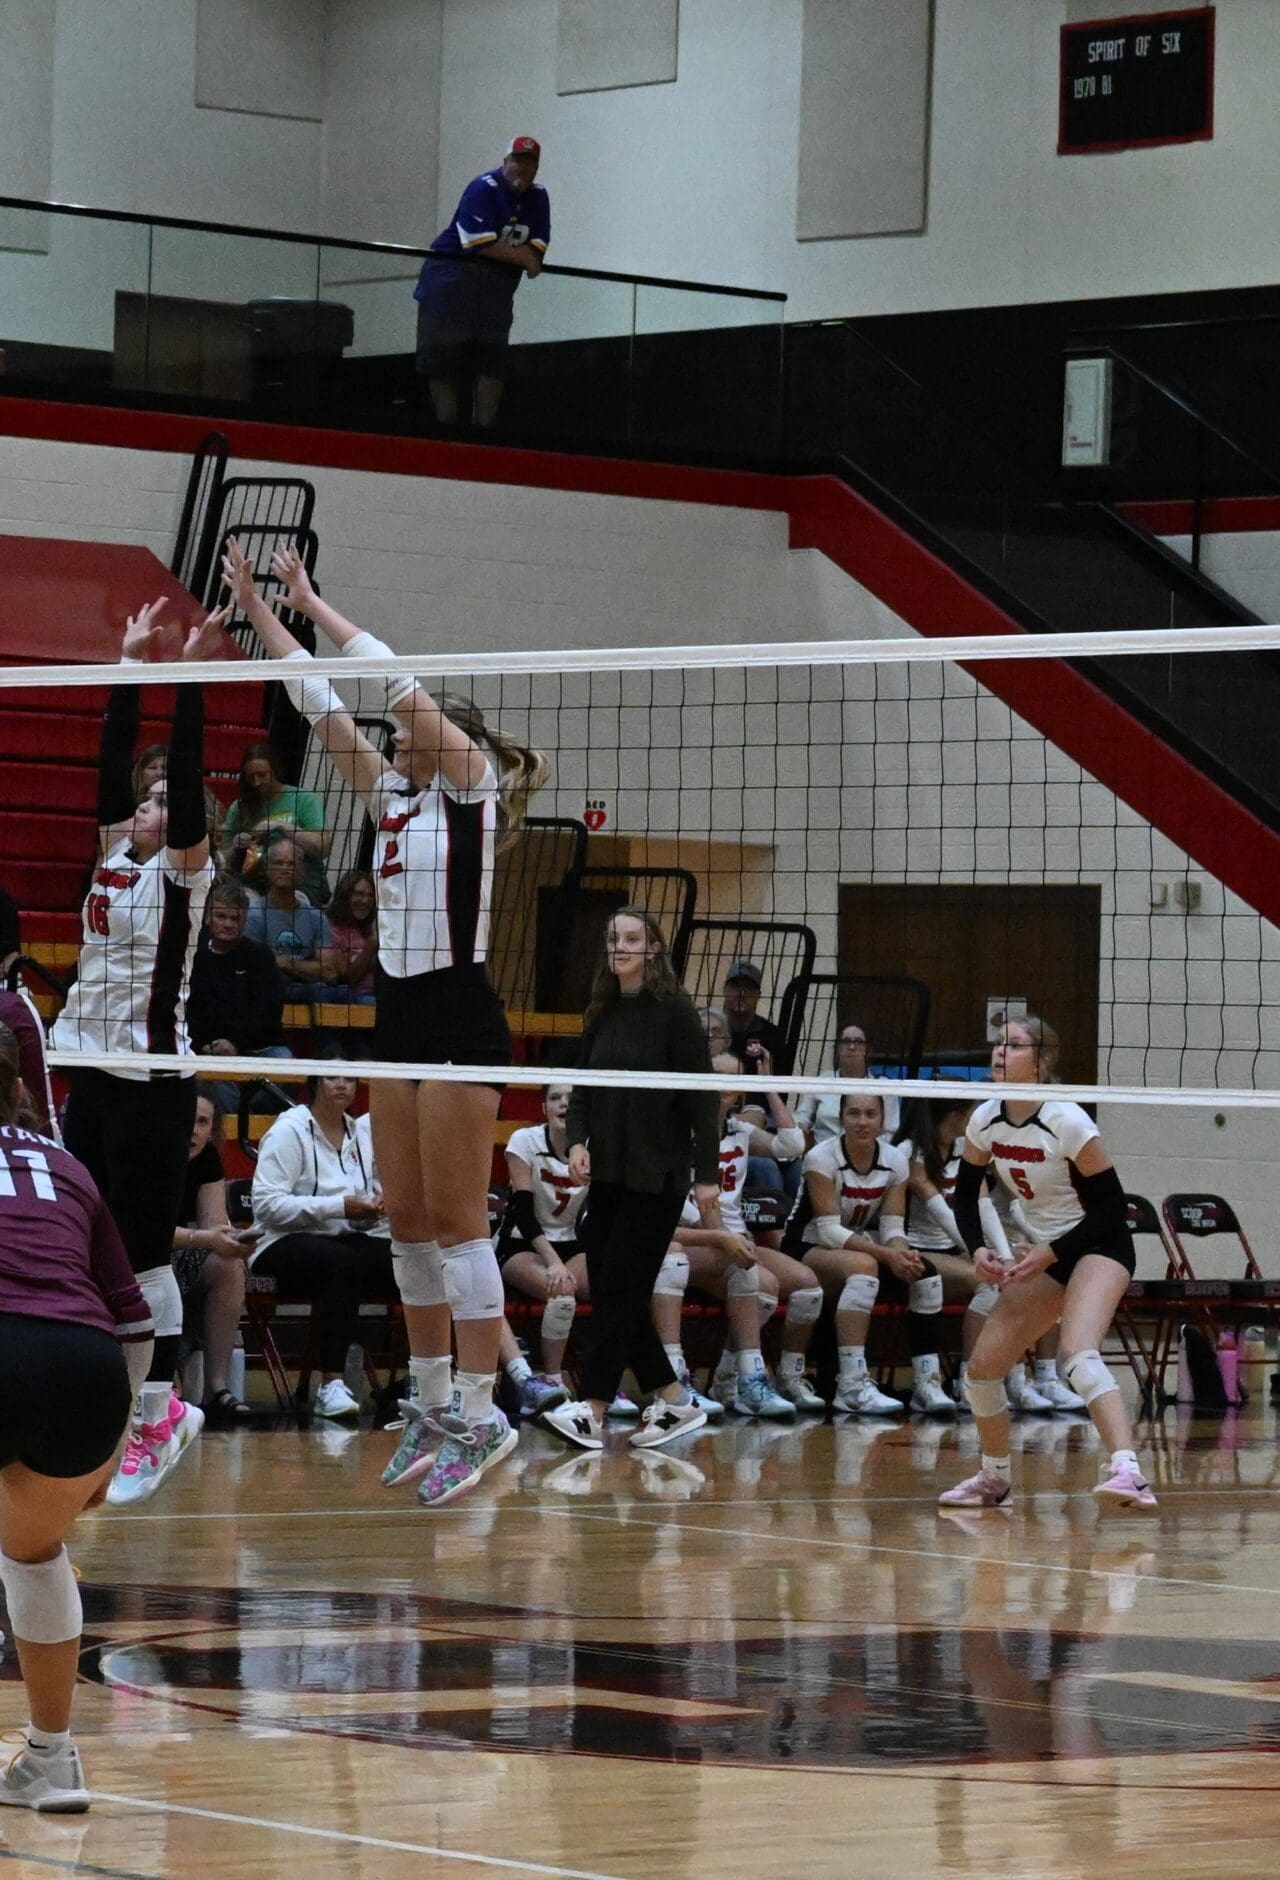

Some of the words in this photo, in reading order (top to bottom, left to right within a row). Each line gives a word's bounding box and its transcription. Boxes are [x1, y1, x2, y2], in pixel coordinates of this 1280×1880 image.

[1087, 38, 1126, 63] SPIRIT
[1135, 35, 1151, 57] OF
[1161, 32, 1182, 55] SIX
[1009, 1167, 1035, 1200] 5
